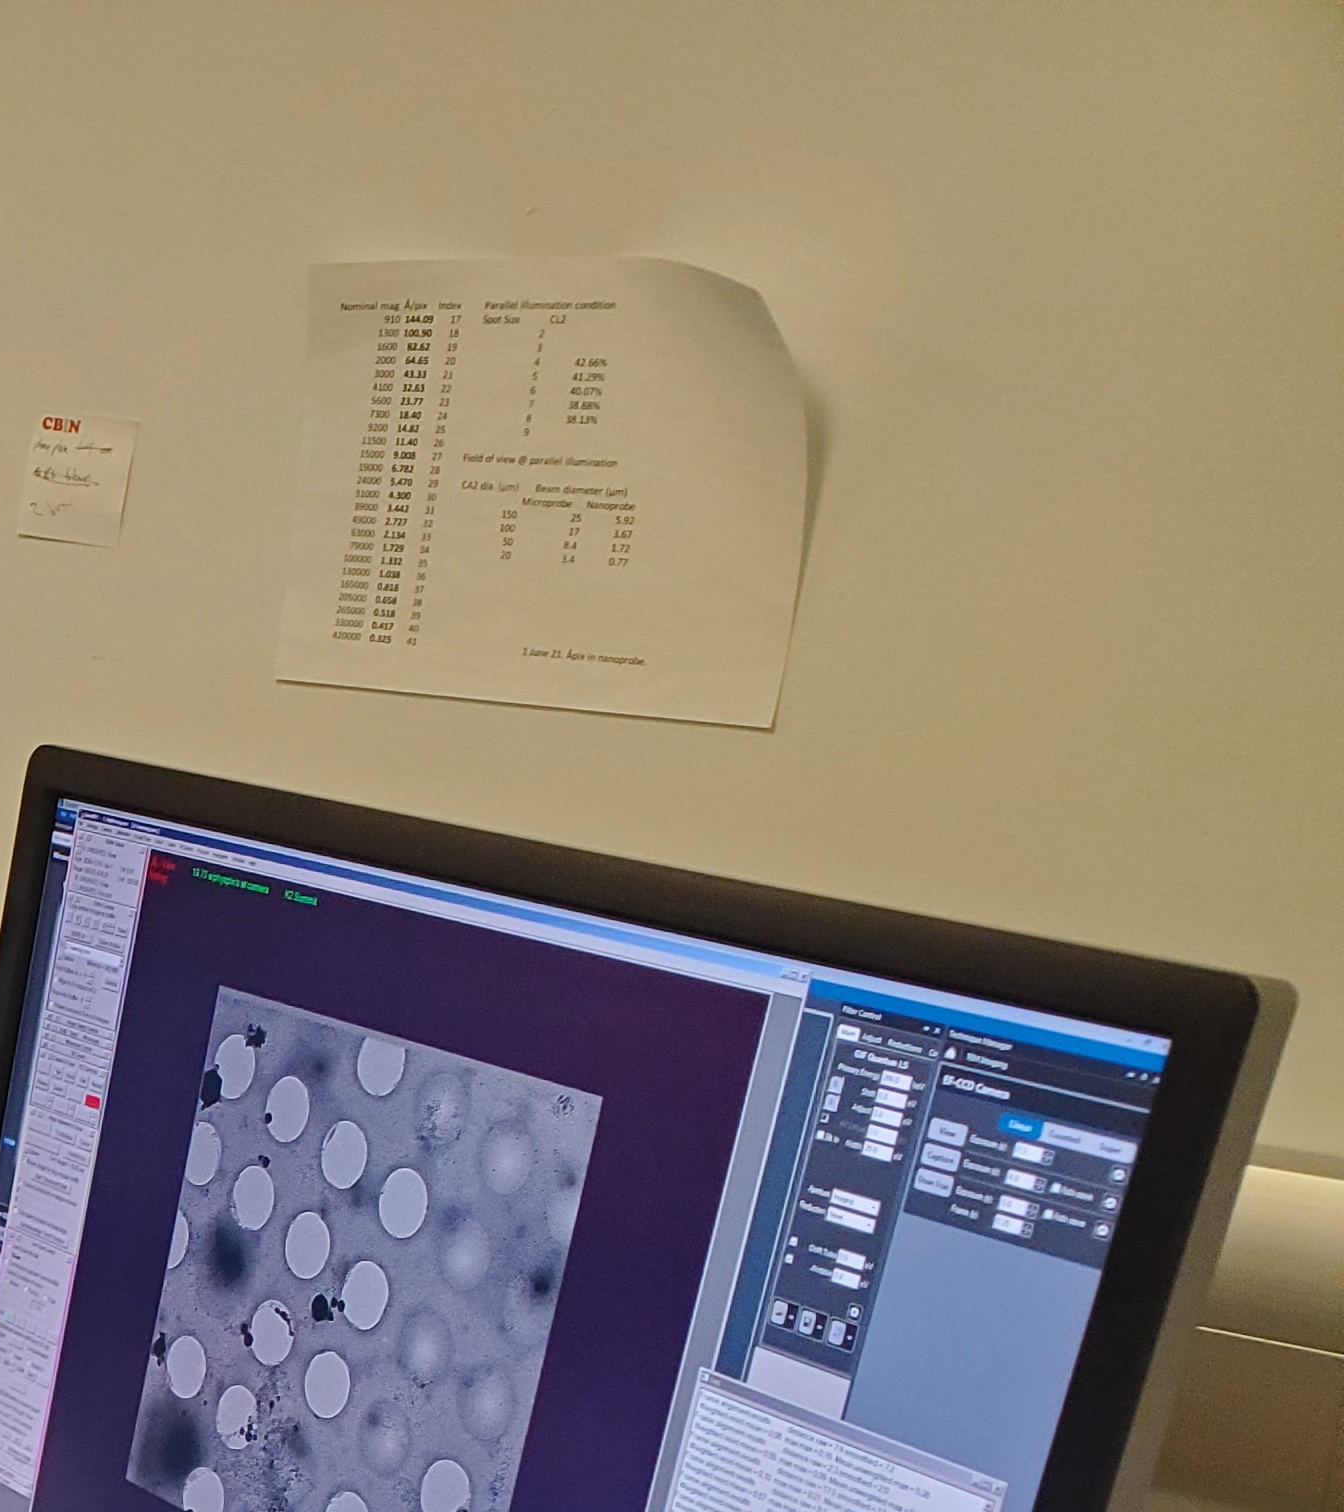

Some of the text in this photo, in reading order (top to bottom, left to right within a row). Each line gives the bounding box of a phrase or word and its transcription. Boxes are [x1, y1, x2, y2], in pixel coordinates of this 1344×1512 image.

[340, 301, 400, 312] Nominal mag
[439, 301, 462, 310] Index
[485, 300, 617, 310] Parallel illumination condition
[384, 315, 462, 324] 910 144.09 17
[483, 315, 521, 325] Spot Size
[550, 315, 566, 324] CL2
[378, 329, 459, 338] 1300 100.90 18
[376, 342, 458, 352] 1600 82.62 19
[375, 356, 456, 365] 2000 64.65 20
[374, 370, 453, 379] 3000 43.33 21
[372, 383, 451, 393] 4100 32.63 22
[371, 397, 450, 407] 5600 23.77 23
[369, 410, 448, 420] 7300 18.40 24
[367, 423, 446, 434] 9200 14.82 25
[463, 453, 484, 464] Field
[485, 454, 494, 463] of
[496, 455, 515, 464] view
[529, 456, 563, 467] parallel
[565, 457, 618, 468] illumination
[535, 484, 560, 494] Beam
[563, 485, 603, 496] diameter
[522, 497, 572, 509] Microprobe
[586, 500, 636, 512] Nanoprobe
[369, 633, 391, 643] 0.325
[529, 648, 550, 658] June
[859, 1009, 882, 1021] Control
